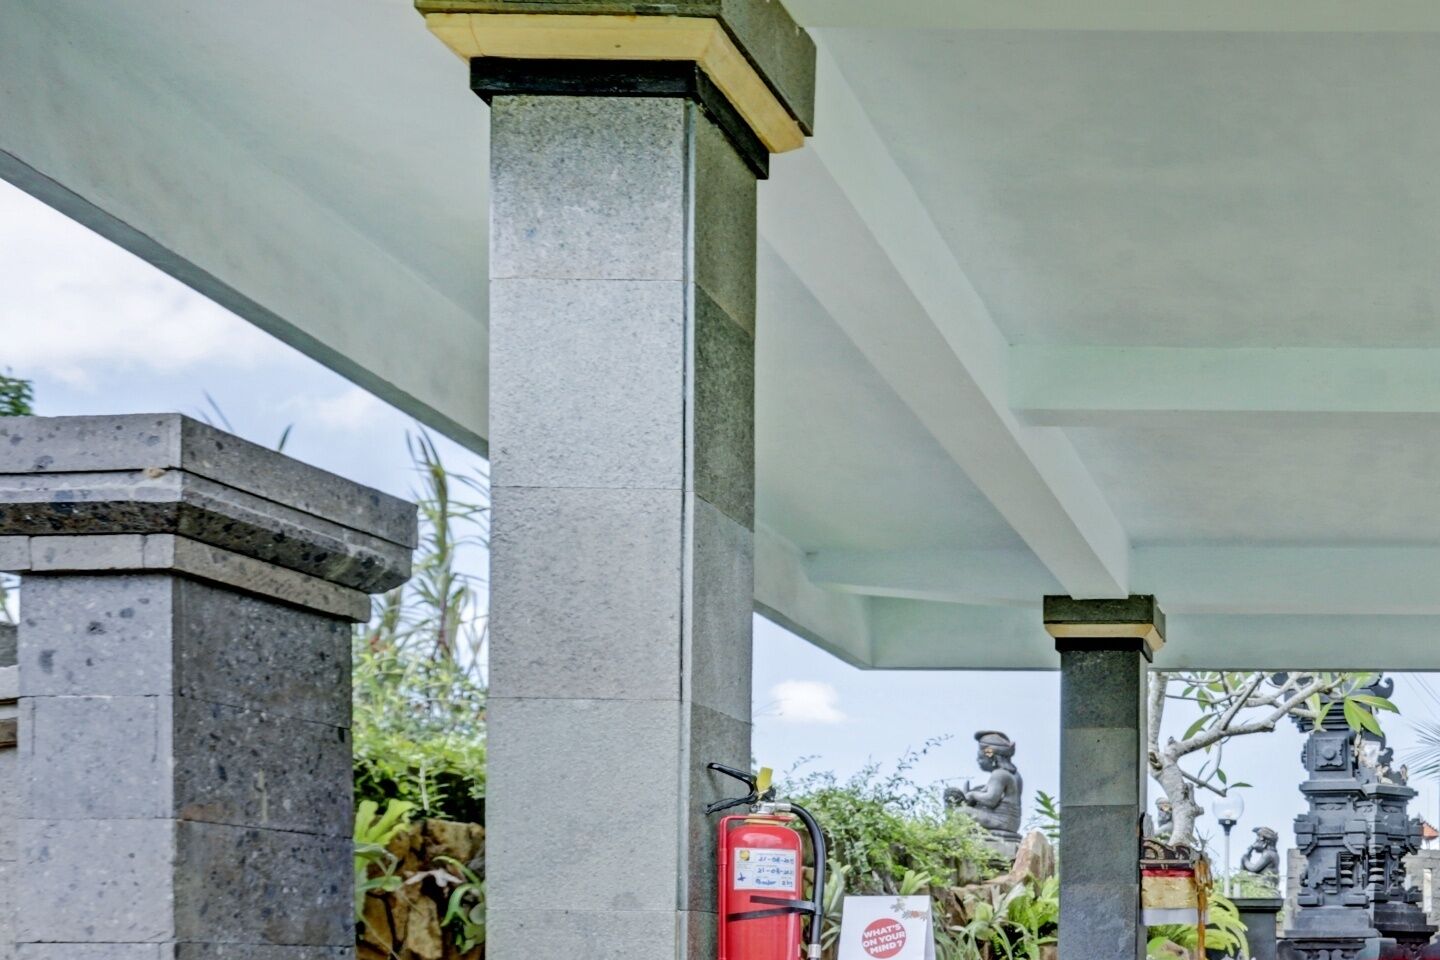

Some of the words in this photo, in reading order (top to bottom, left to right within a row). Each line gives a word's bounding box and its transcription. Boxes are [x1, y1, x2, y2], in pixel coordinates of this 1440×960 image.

[863, 923, 902, 938] WHAT'S
[863, 938, 878, 948] ON
[879, 931, 906, 943] YOUR
